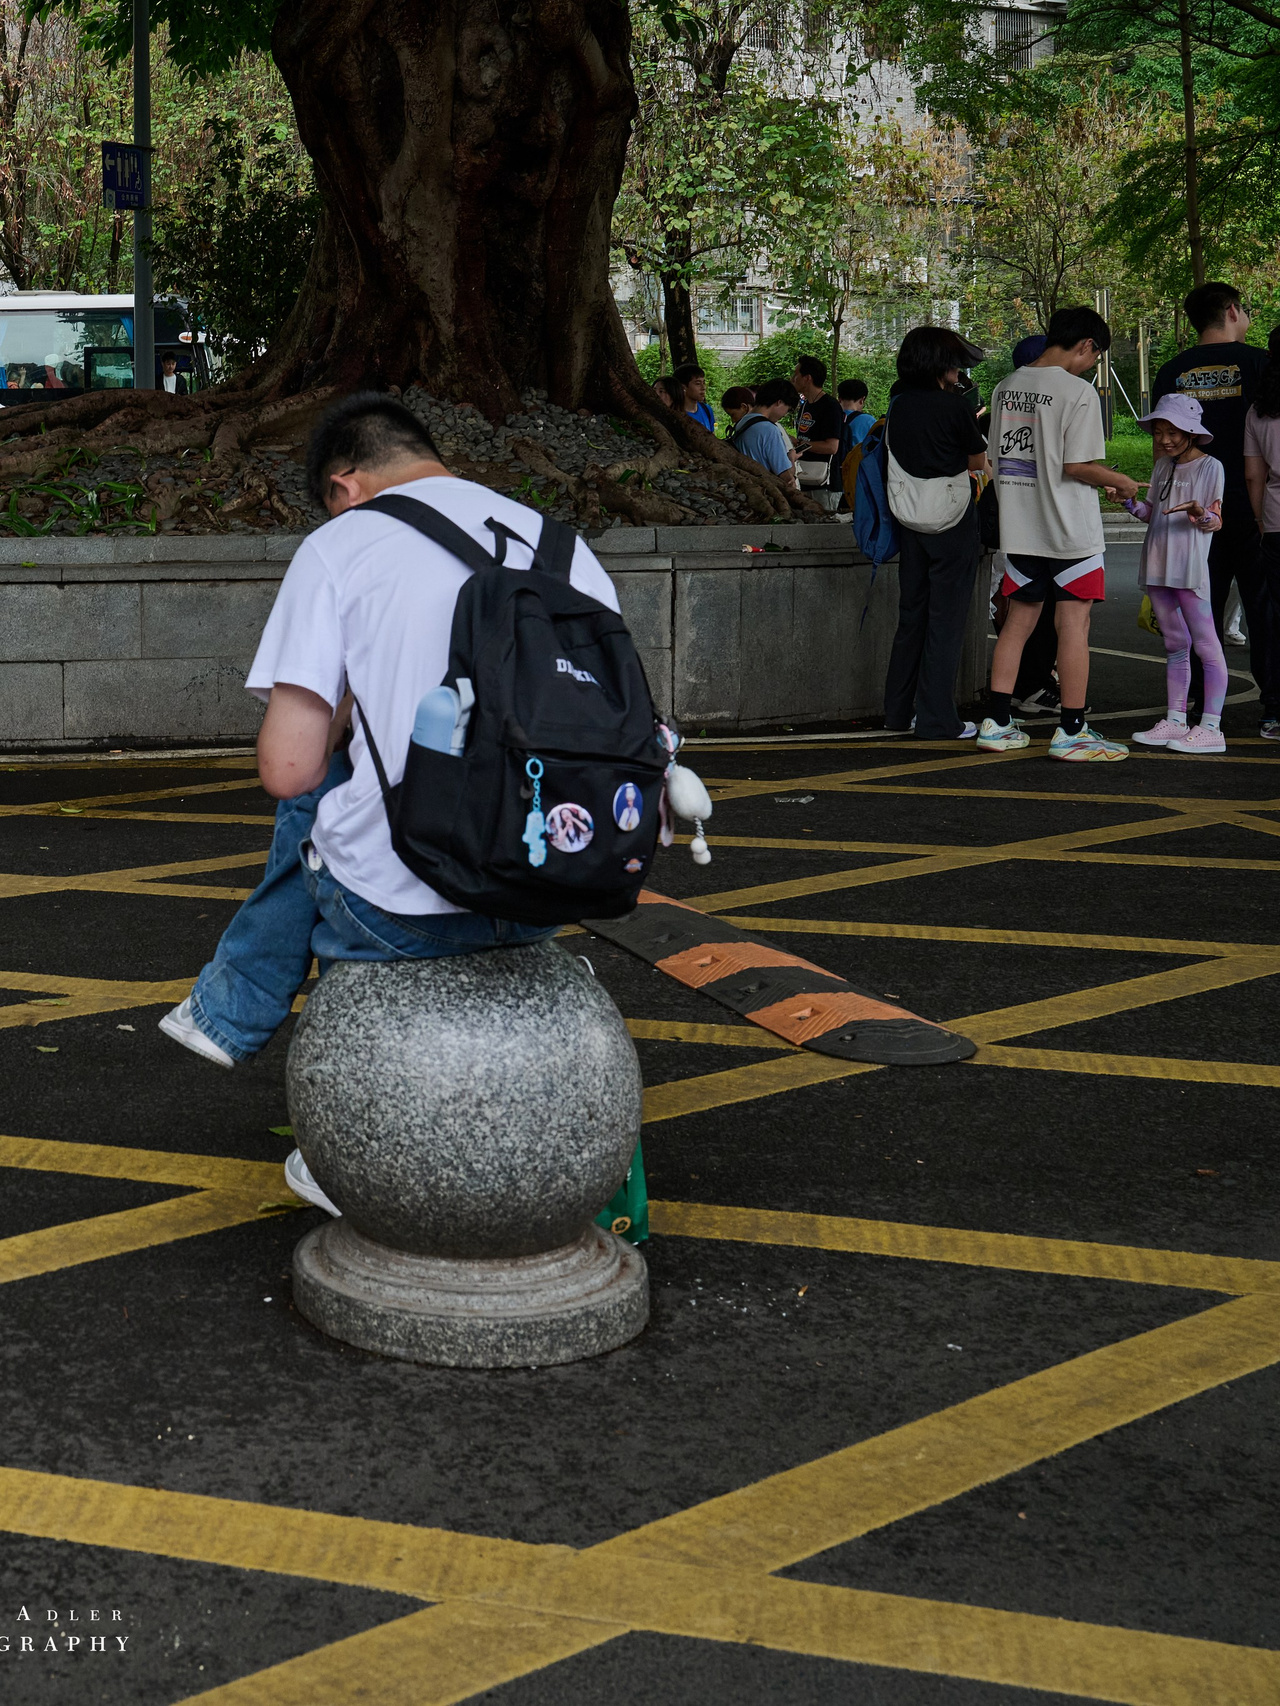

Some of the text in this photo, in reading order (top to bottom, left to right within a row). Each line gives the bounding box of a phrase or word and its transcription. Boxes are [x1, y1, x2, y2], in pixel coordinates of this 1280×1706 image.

[998, 390, 1053, 407] NOW YOUR
[1220, 387, 1238, 396] CLUB
[1000, 400, 1036, 414] POWER
